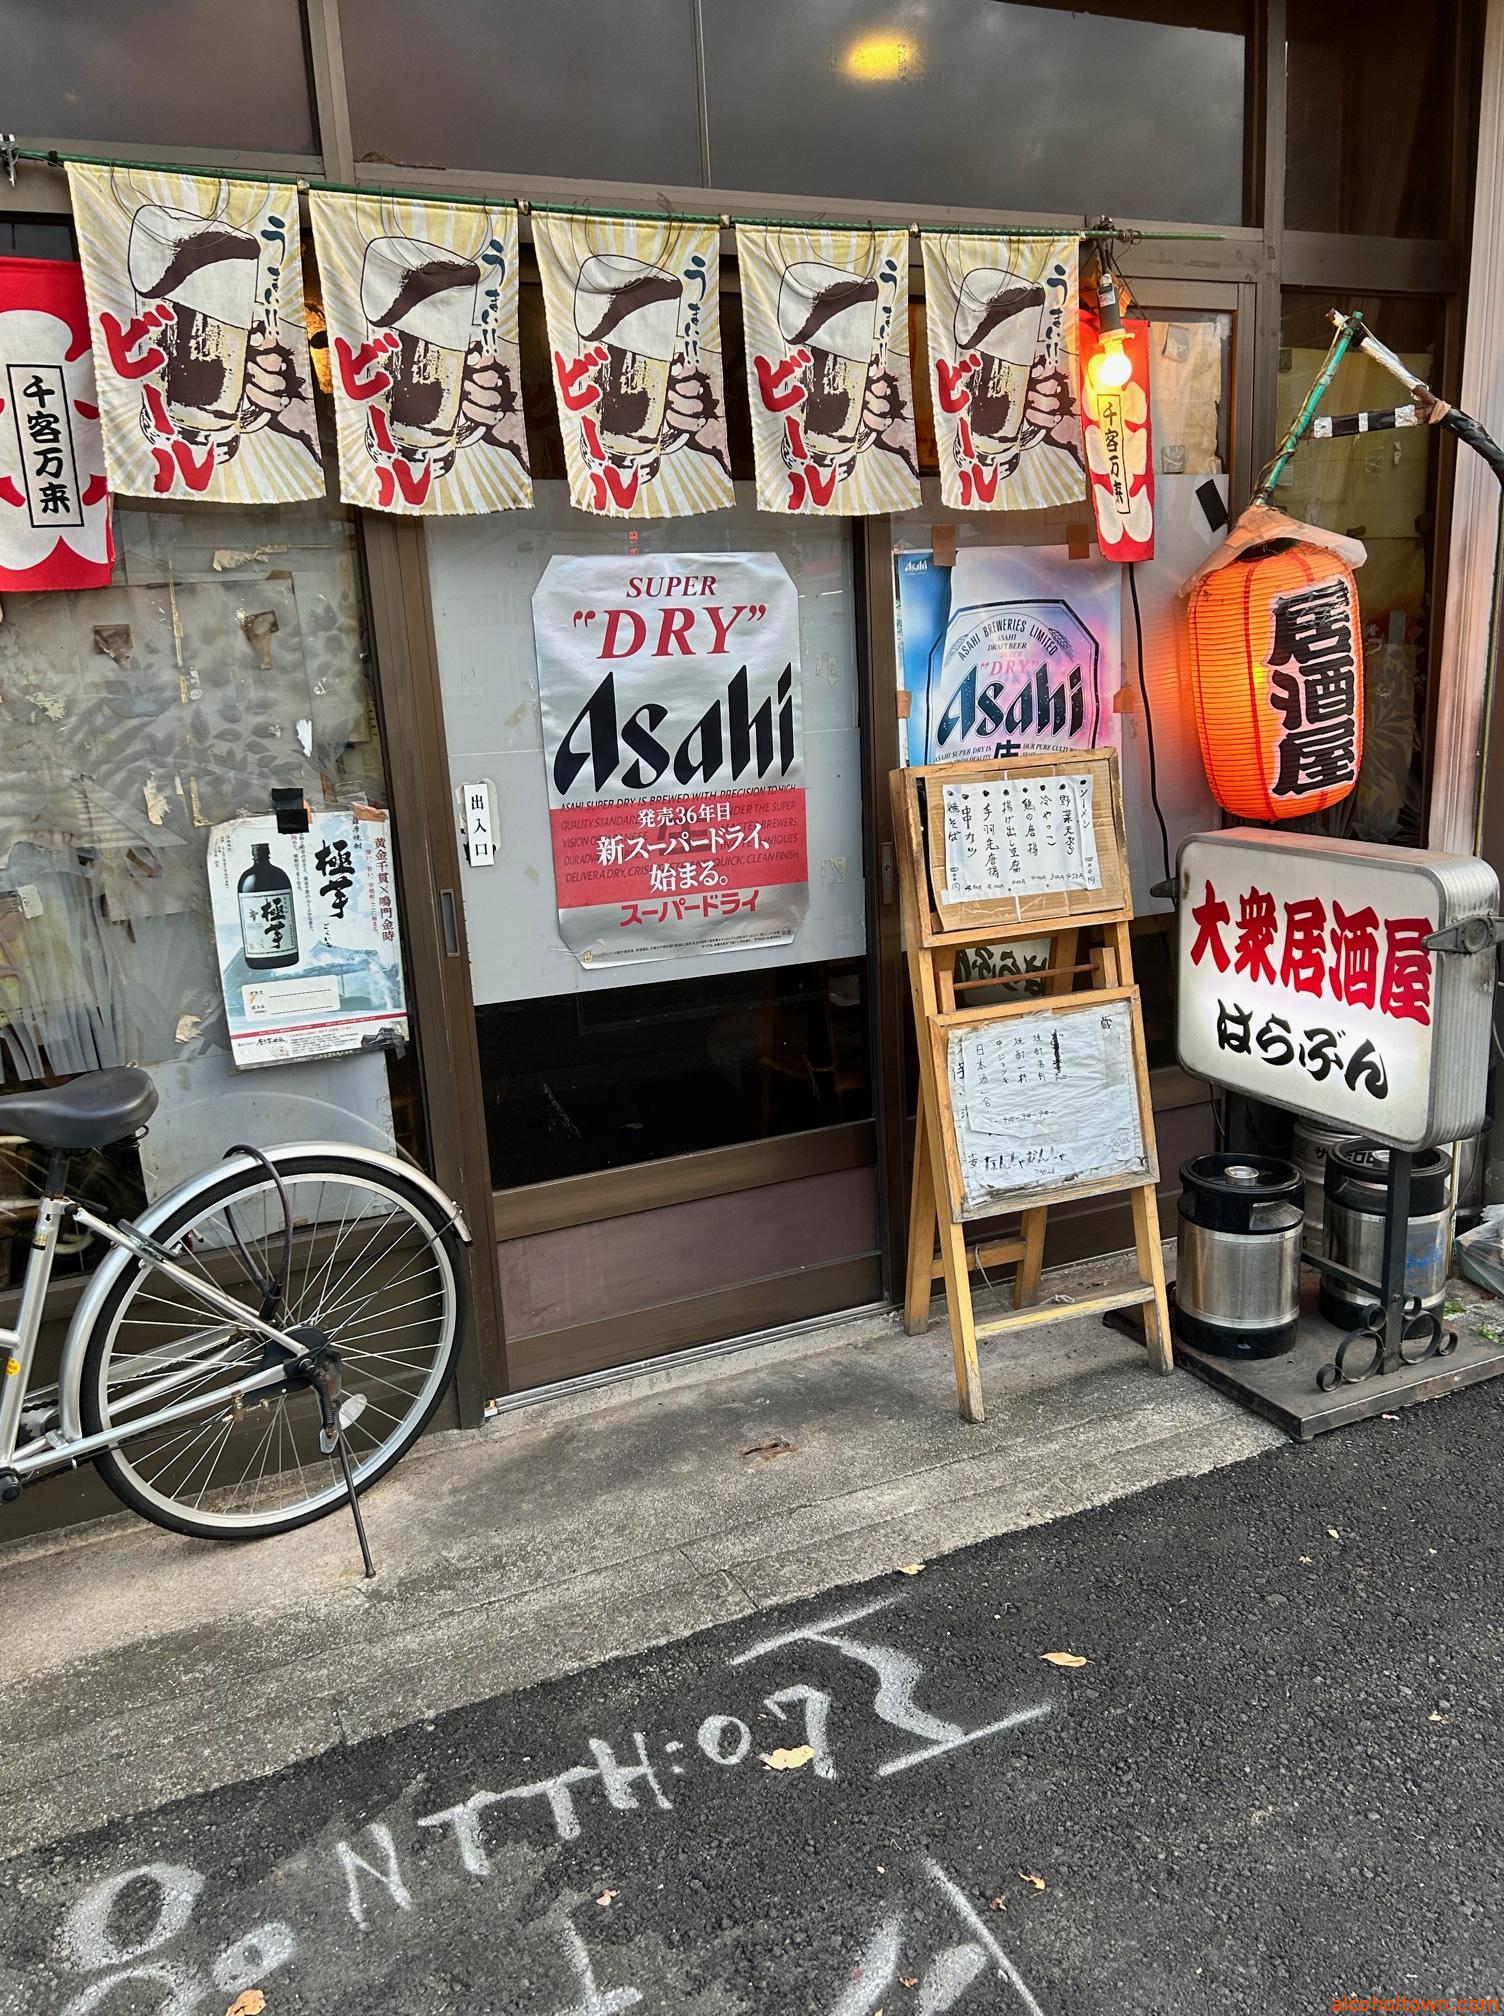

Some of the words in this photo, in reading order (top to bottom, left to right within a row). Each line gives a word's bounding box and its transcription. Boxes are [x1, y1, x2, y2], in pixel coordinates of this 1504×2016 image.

[100, 304, 215, 493] ビール
[334, 332, 432, 507] ビール
[23, 375, 71, 514] 千客万来
[554, 347, 639, 511] ビール
[752, 348, 837, 510] ビール
[935, 354, 1000, 506] ビール
[1103, 401, 1124, 504] 千客万来
[626, 575, 717, 598] SUPER
[958, 633, 981, 661] ASAHI
[983, 618, 1027, 637] BREWERIES
[1029, 624, 1058, 656] LIMITED
[1008, 642, 1028, 650] BEER
[937, 663, 1084, 746] Asahi
[1267, 579, 1355, 796] 居酒屋
[554, 662, 794, 795] Asahi
[951, 749, 971, 758] SUPER
[972, 746, 985, 754] DRY
[471, 795, 489, 856] 出入口
[561, 803, 584, 812] ASAHI
[586, 800, 614, 811] SUPER
[615, 798, 636, 808] DRY
[639, 796, 647, 806] IS
[649, 793, 690, 806] BREWED
[692, 791, 717, 801] WITH
[720, 786, 765, 798] PRECISION
[767, 786, 777, 794] TO
[561, 818, 594, 831] QUALITY
[755, 804, 769, 813] THE
[638, 803, 731, 829] 発売36年目
[1040, 795, 1057, 846] 冷やっこ
[1059, 795, 1075, 855] 野菜天ぷら
[562, 838, 588, 849] VISION
[597, 823, 770, 867] 新スーパードライ、
[961, 805, 977, 858] 串カツ
[563, 855, 579, 865] OUR
[566, 870, 600, 883] DELIVER
[628, 865, 650, 876] CRIS
[747, 851, 776, 863] CLEAN
[649, 860, 729, 893] 始まる。
[620, 890, 760, 927] スーパードライ
[1190, 879, 1433, 1027] 大衆居酒屋
[1216, 998, 1391, 1101] はらぶん
